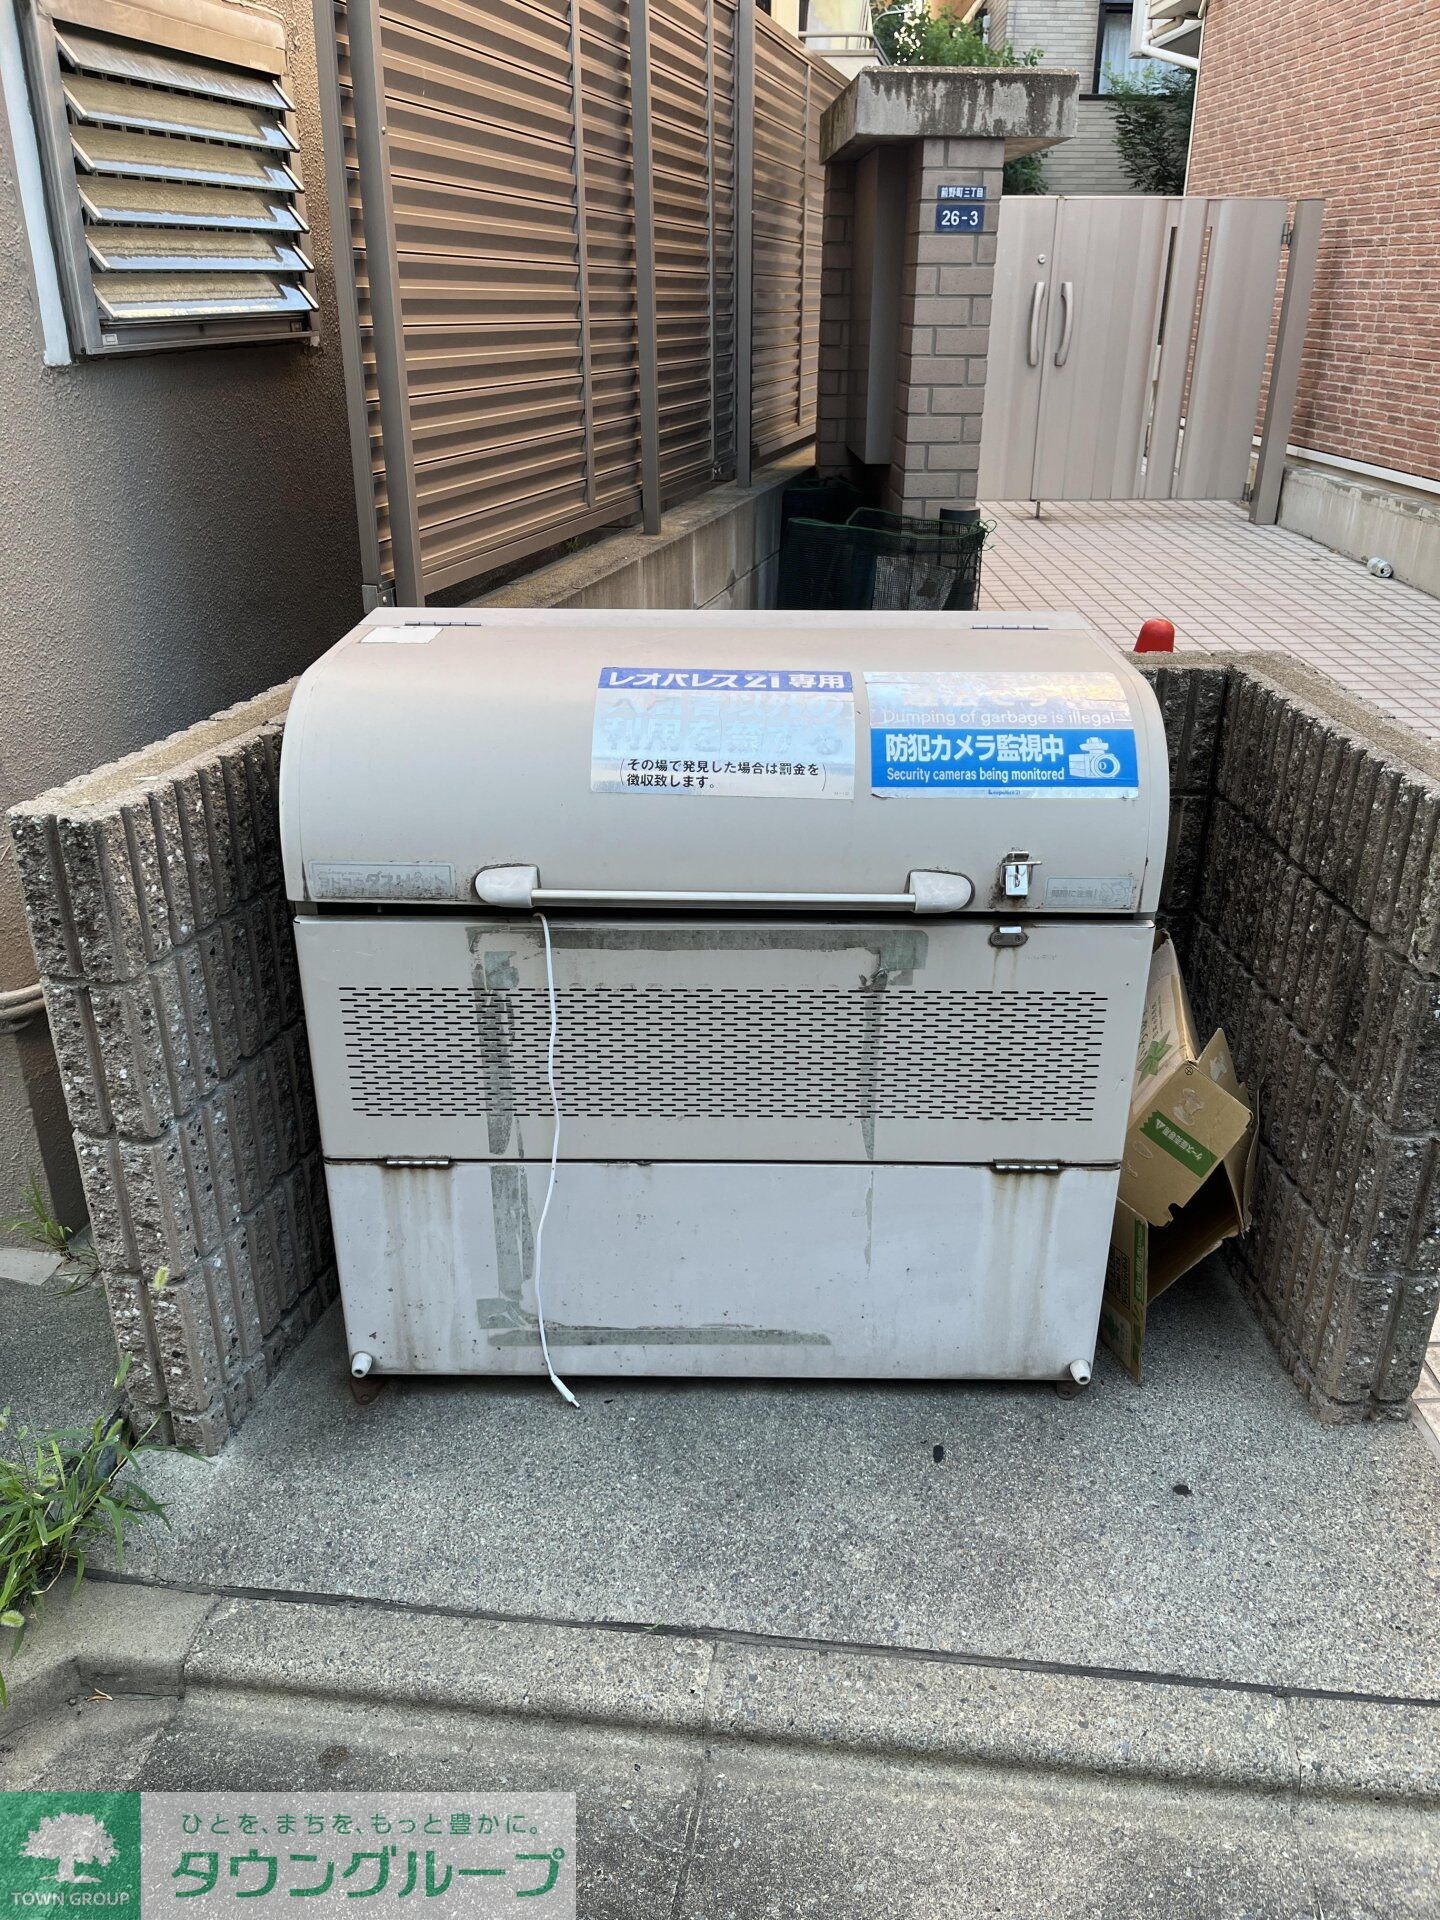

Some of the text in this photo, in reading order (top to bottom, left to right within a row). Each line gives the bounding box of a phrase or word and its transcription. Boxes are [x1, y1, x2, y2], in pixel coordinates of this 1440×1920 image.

[941, 210, 979, 226] 26-3
[882, 710, 1115, 726] Dumping of garbage is illegal
[885, 733, 1064, 763] 防犯カメラ監視中
[887, 767, 1065, 783] Security cameras being monitored
